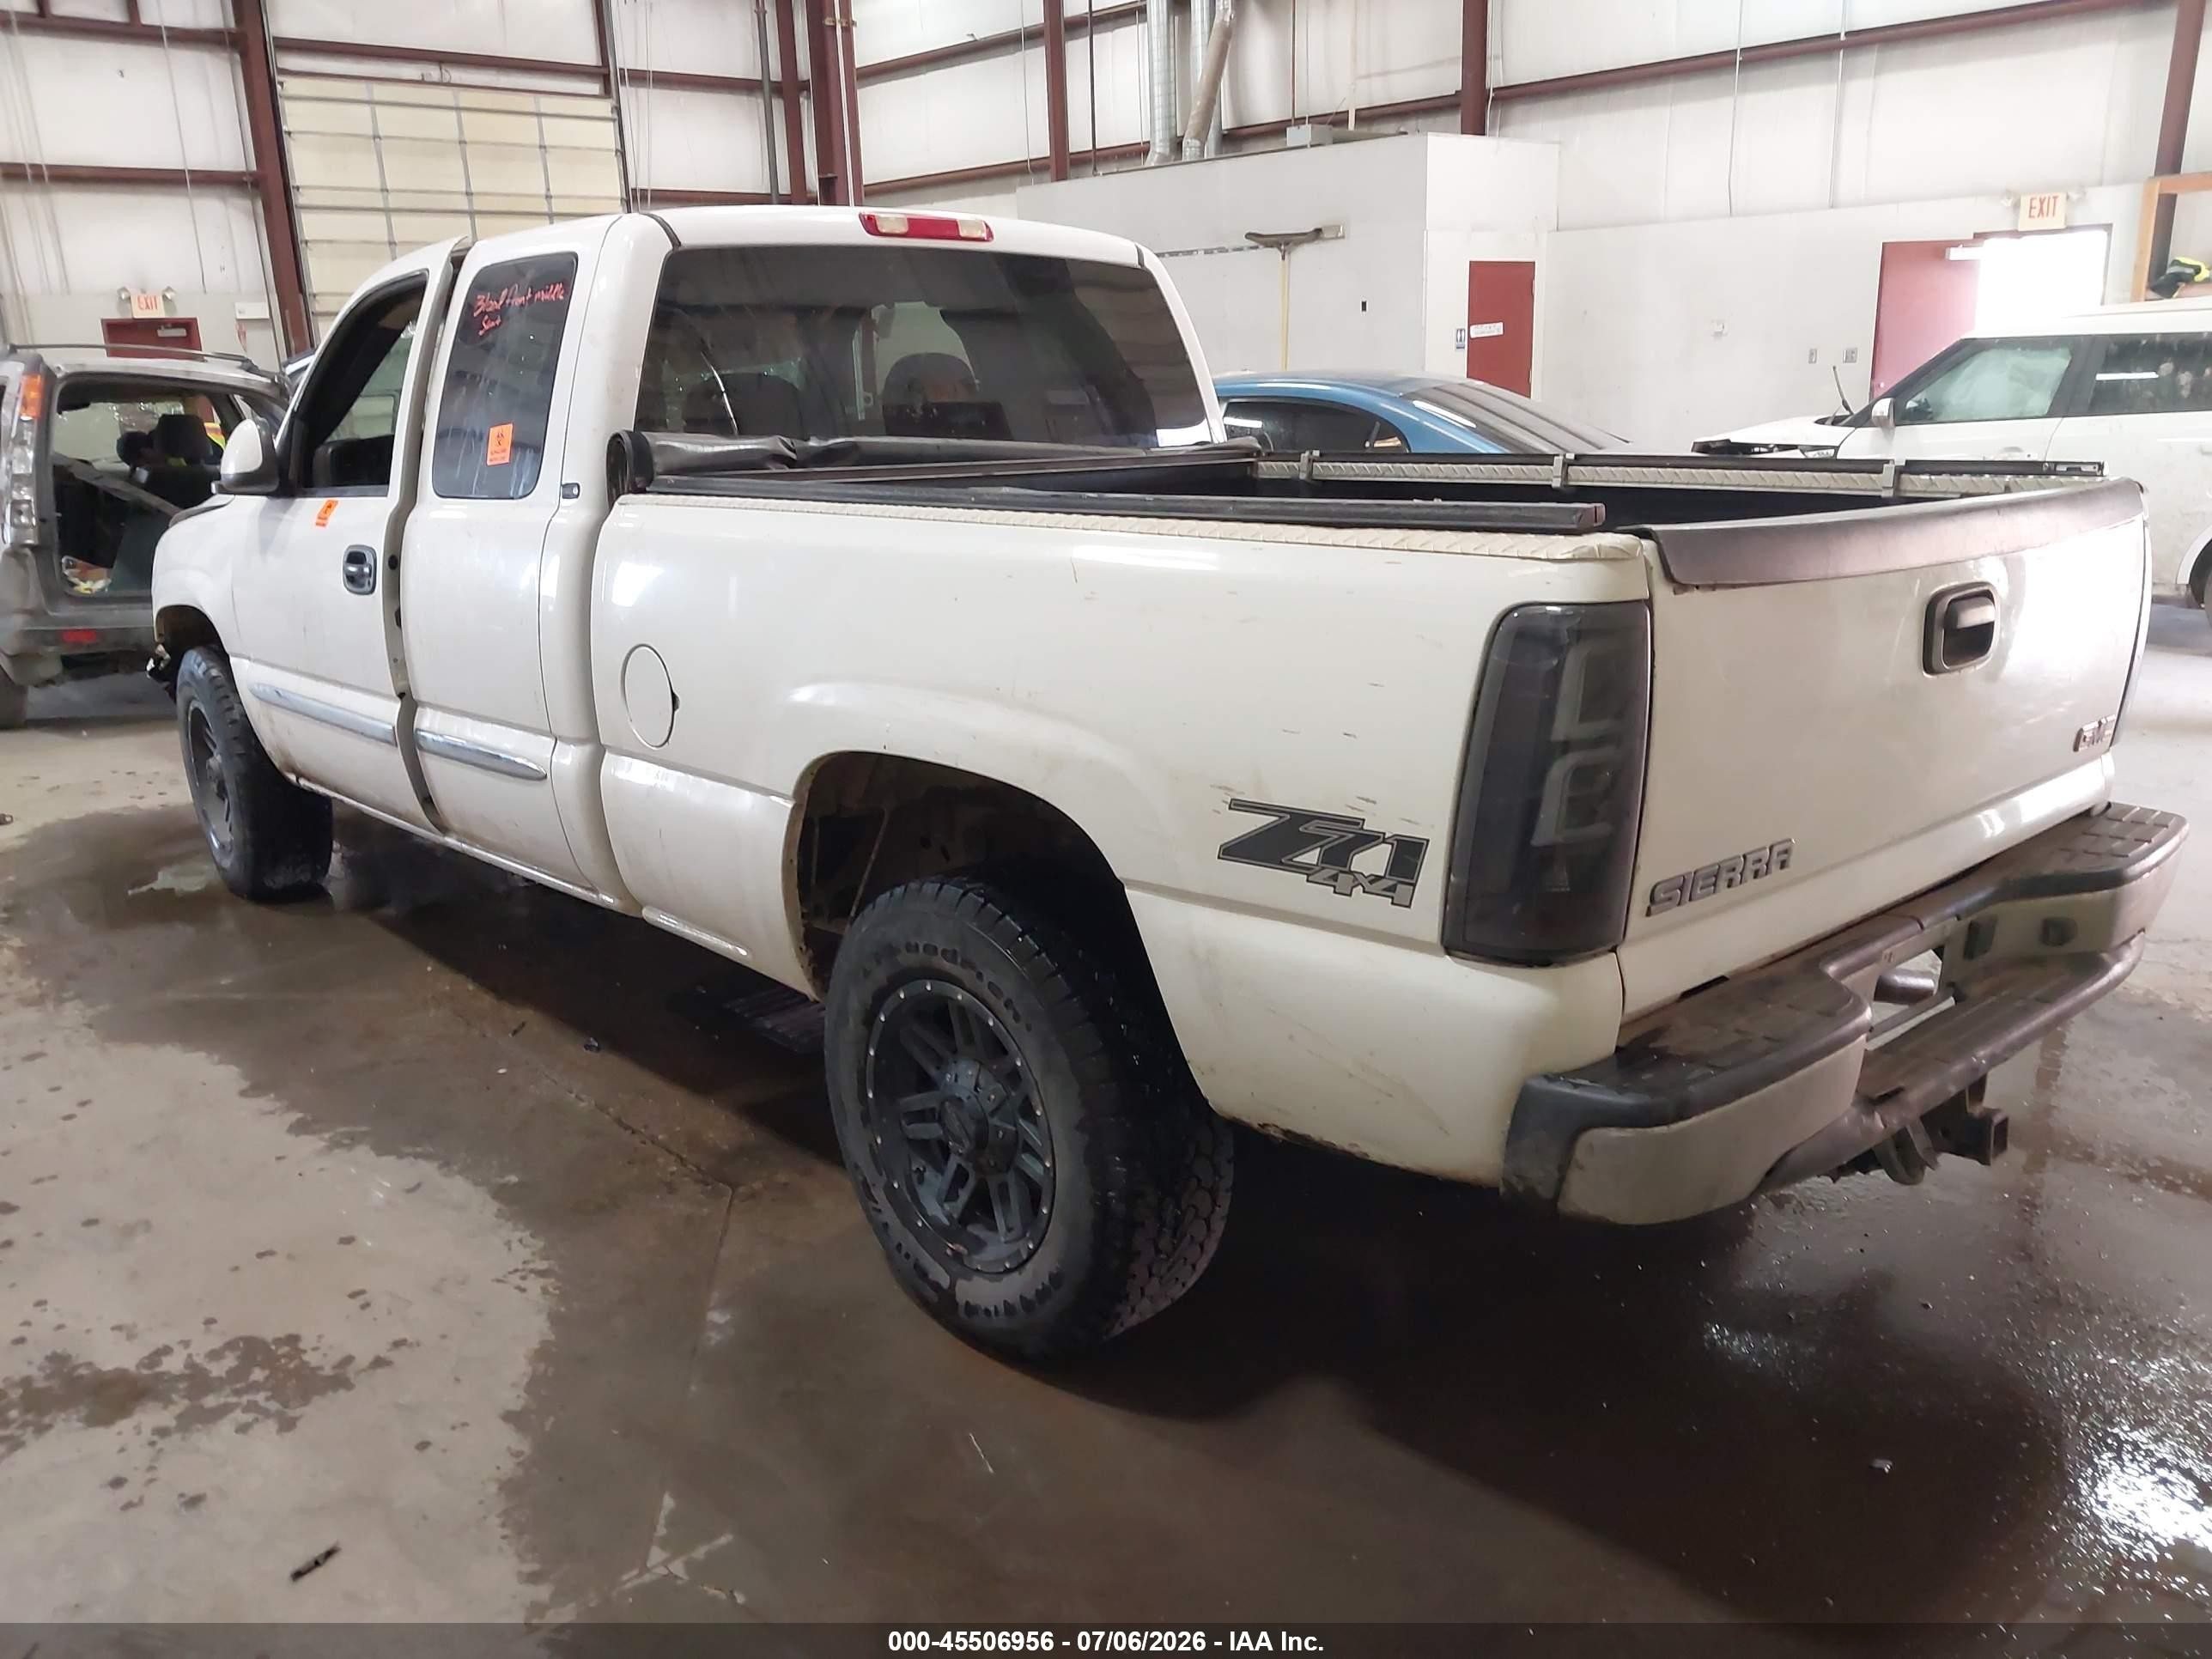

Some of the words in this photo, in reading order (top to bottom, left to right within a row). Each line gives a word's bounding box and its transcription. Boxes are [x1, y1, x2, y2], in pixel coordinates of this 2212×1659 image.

[2028, 195, 2059, 218] EXIT
[137, 295, 159, 310] EXIT
[1218, 798, 1430, 884] Z71
[1645, 837, 1796, 917] SIERRA
